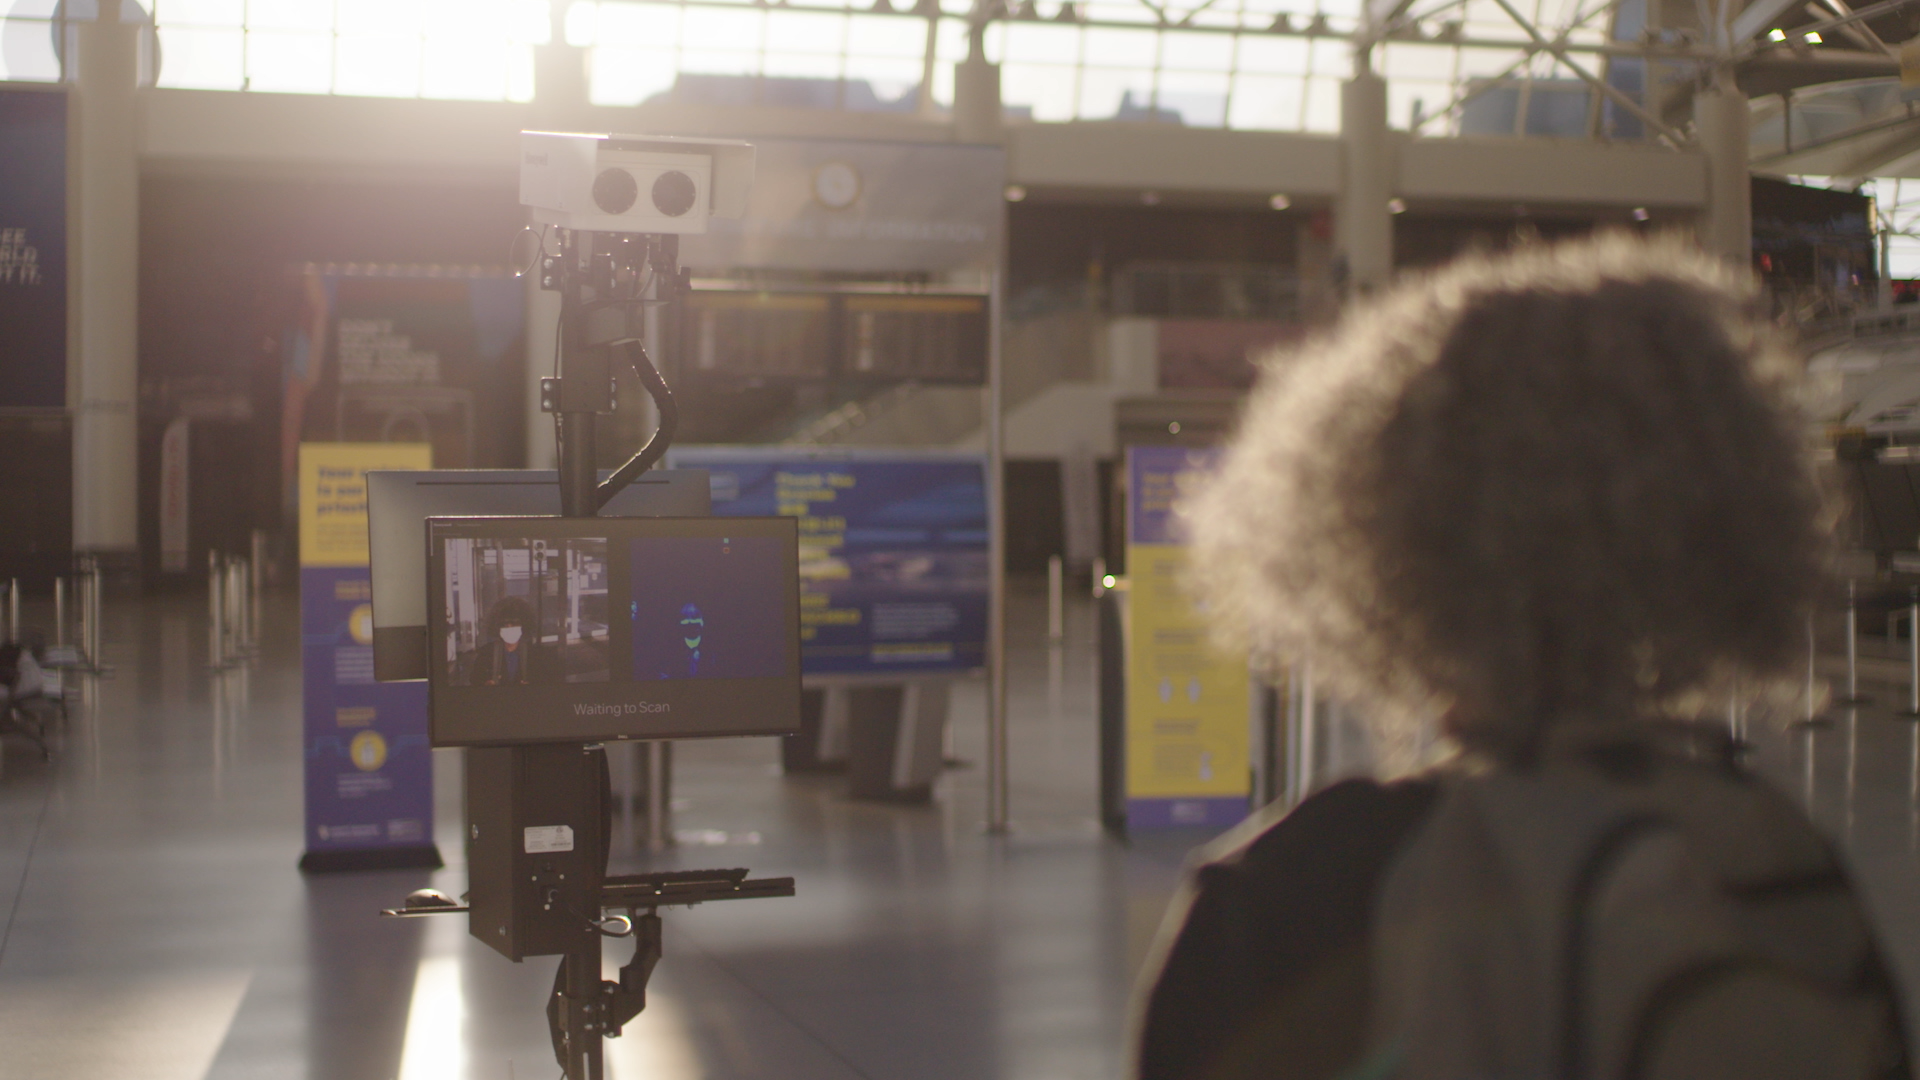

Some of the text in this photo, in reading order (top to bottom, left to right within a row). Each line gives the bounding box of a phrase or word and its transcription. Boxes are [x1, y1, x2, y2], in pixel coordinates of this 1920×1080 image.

[573, 700, 670, 717] Waiting to Scan
